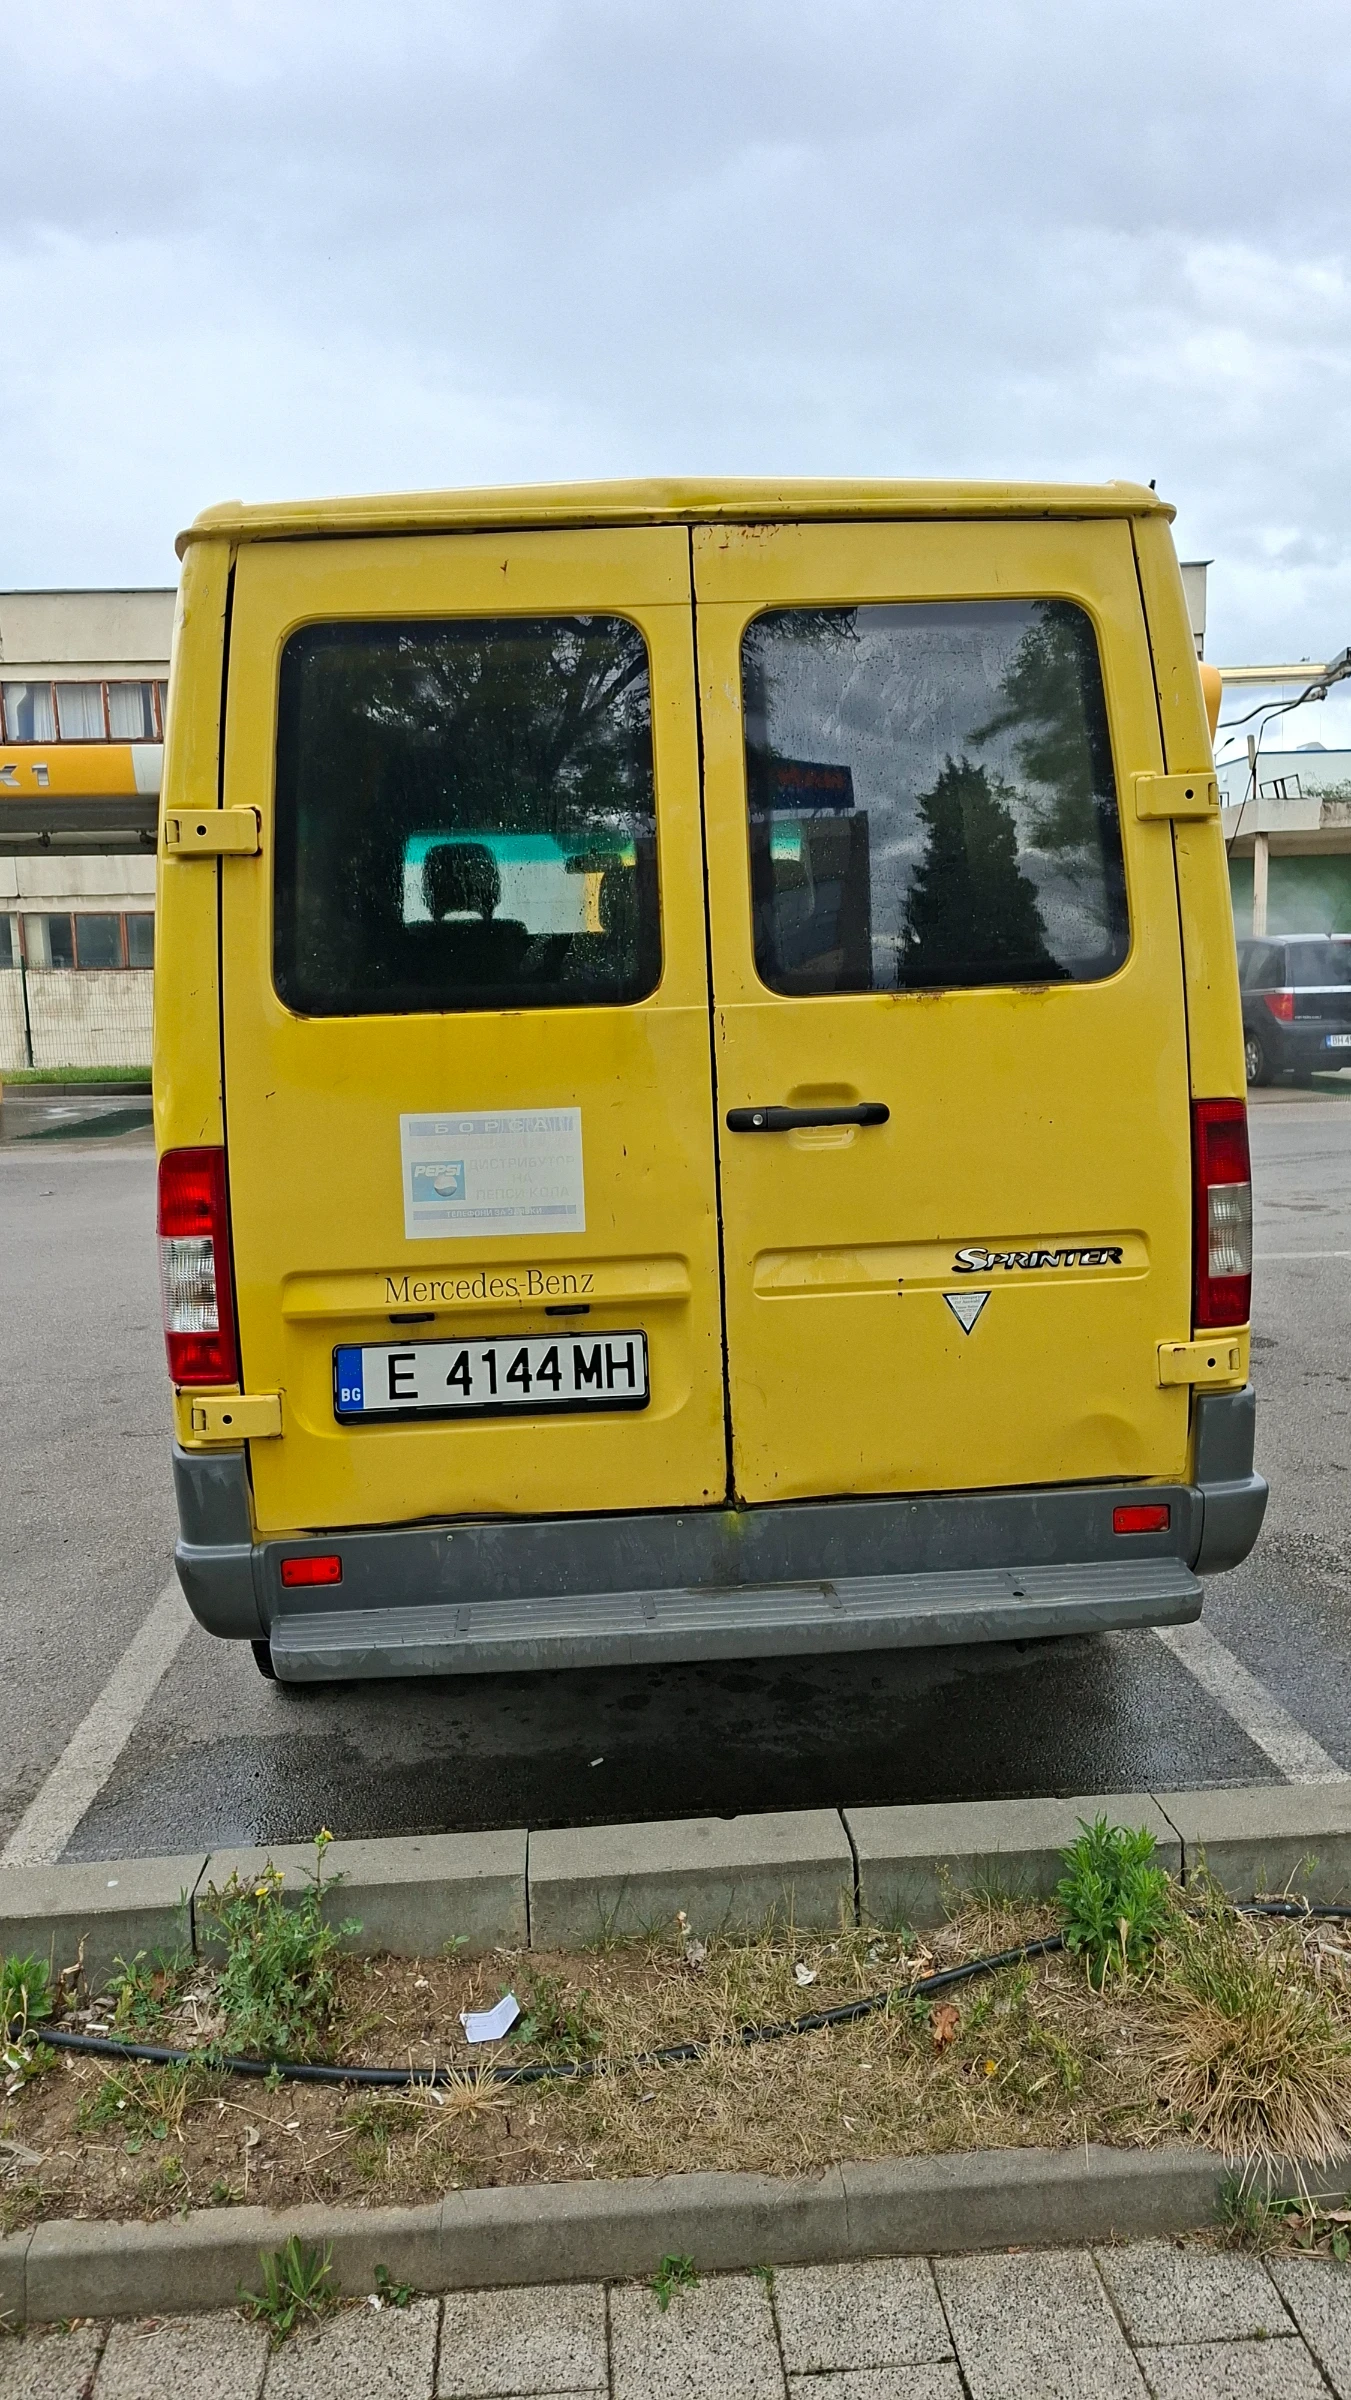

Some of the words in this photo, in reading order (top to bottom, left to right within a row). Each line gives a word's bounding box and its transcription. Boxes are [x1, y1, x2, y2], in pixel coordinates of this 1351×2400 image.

[434, 1119, 548, 1134] БОРСА
[414, 1164, 461, 1177] PEPSI
[469, 1155, 575, 1172] ДИСТРИБУТОР
[476, 1189, 526, 1201] ПЕПСИ
[384, 1269, 595, 1304] Mercedes-Benz
[387, 1352, 419, 1400] E
[446, 1345, 563, 1396] 4144
[341, 1387, 361, 1402] BG
